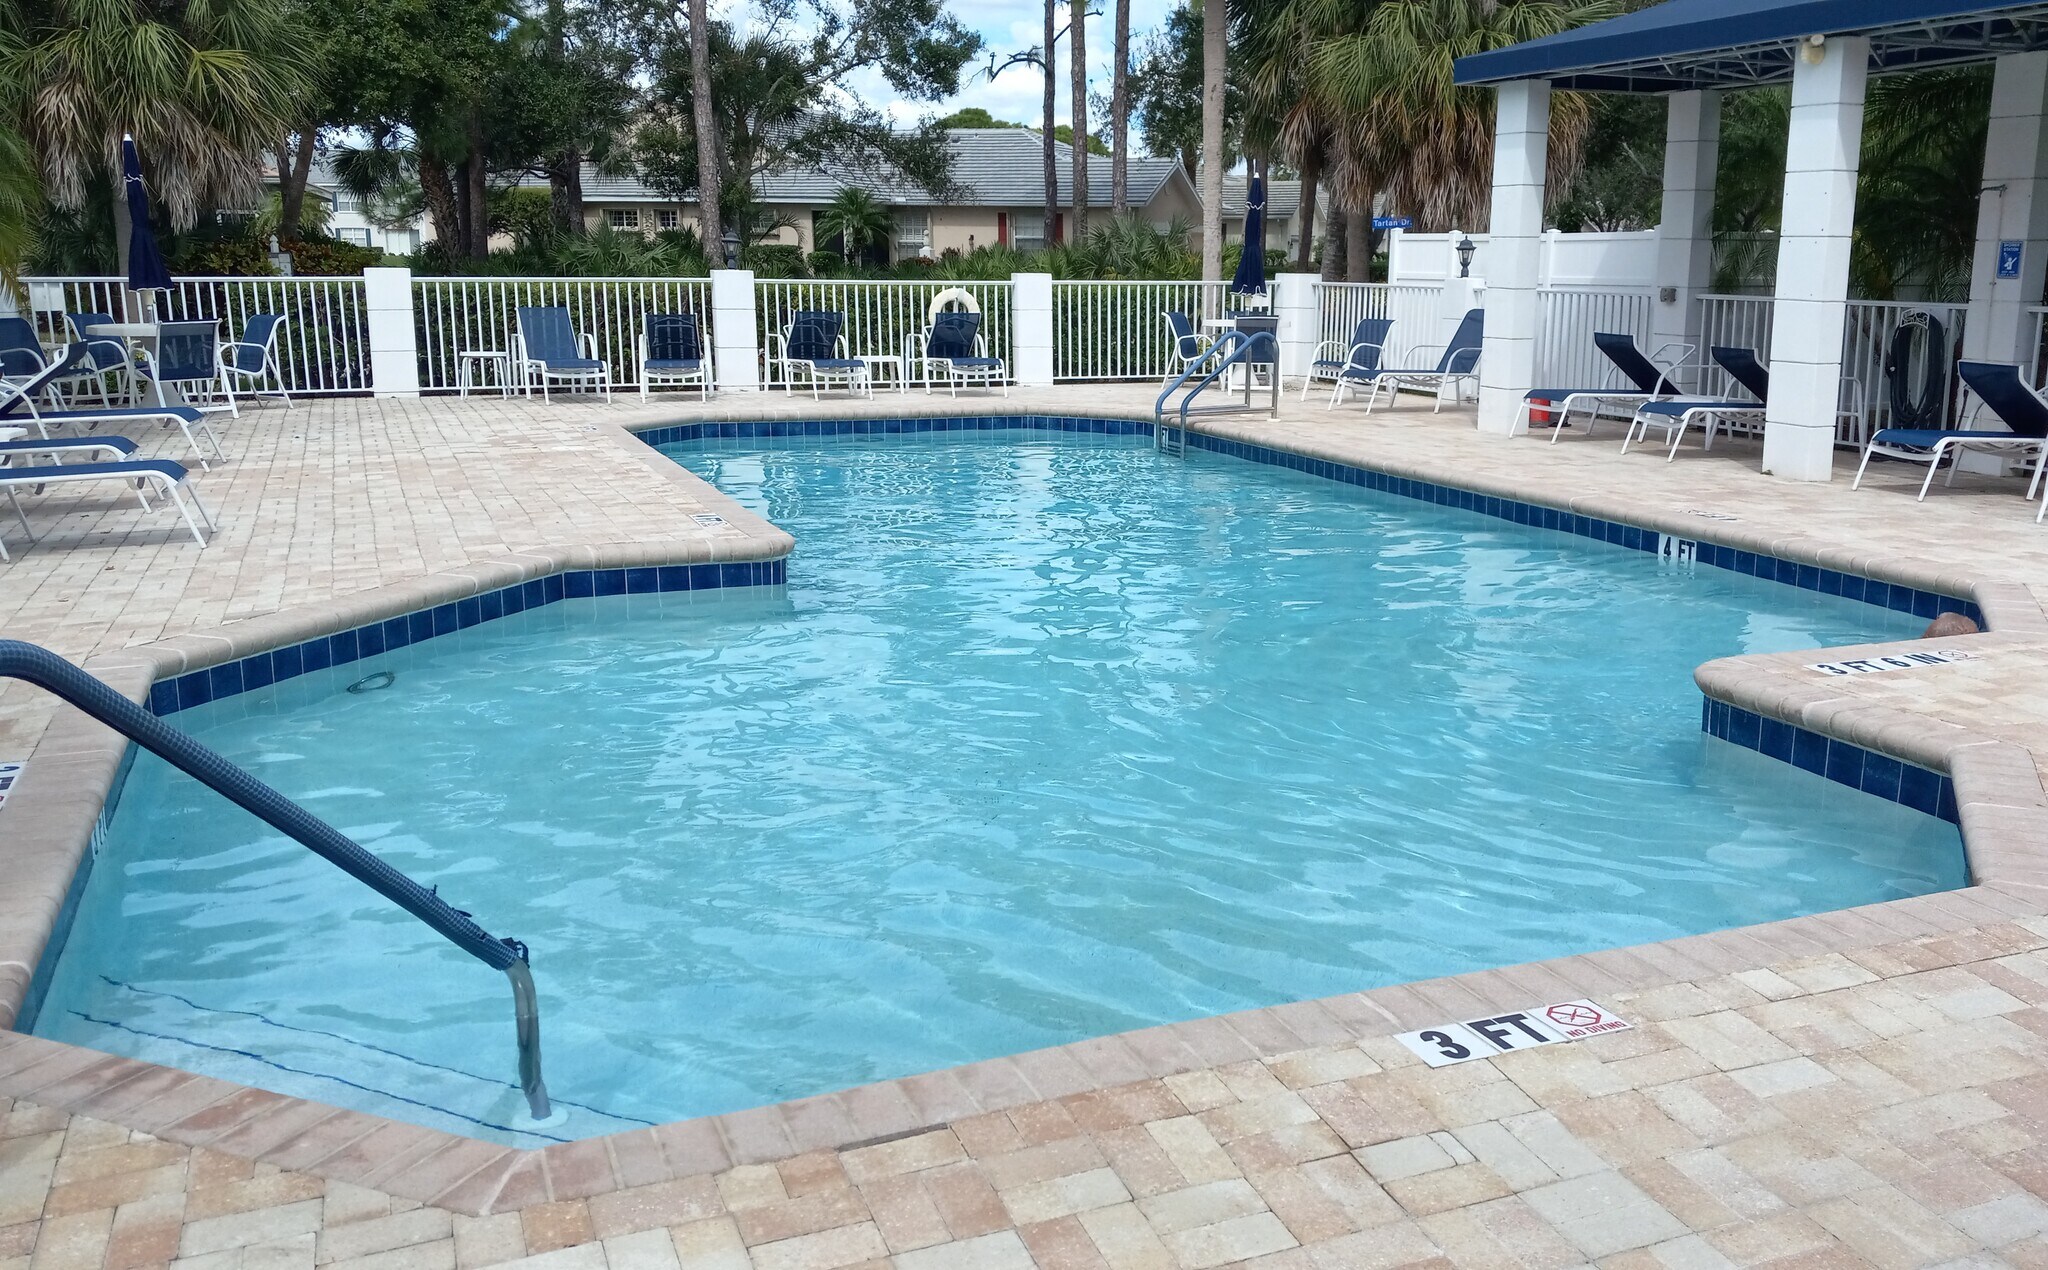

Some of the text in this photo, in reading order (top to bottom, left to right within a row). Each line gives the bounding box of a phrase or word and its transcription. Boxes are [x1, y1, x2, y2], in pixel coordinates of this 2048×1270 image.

[1373, 219, 1398, 227] Tartan
[1663, 536, 1695, 560] 4 FT
[1817, 664, 1848, 675] 3
[1841, 660, 1885, 673] FT
[1881, 657, 1911, 668] 6
[1903, 653, 1950, 665] IN
[1419, 1013, 1550, 1059] 3 FT
[1566, 1021, 1628, 1038] NO DIVING
